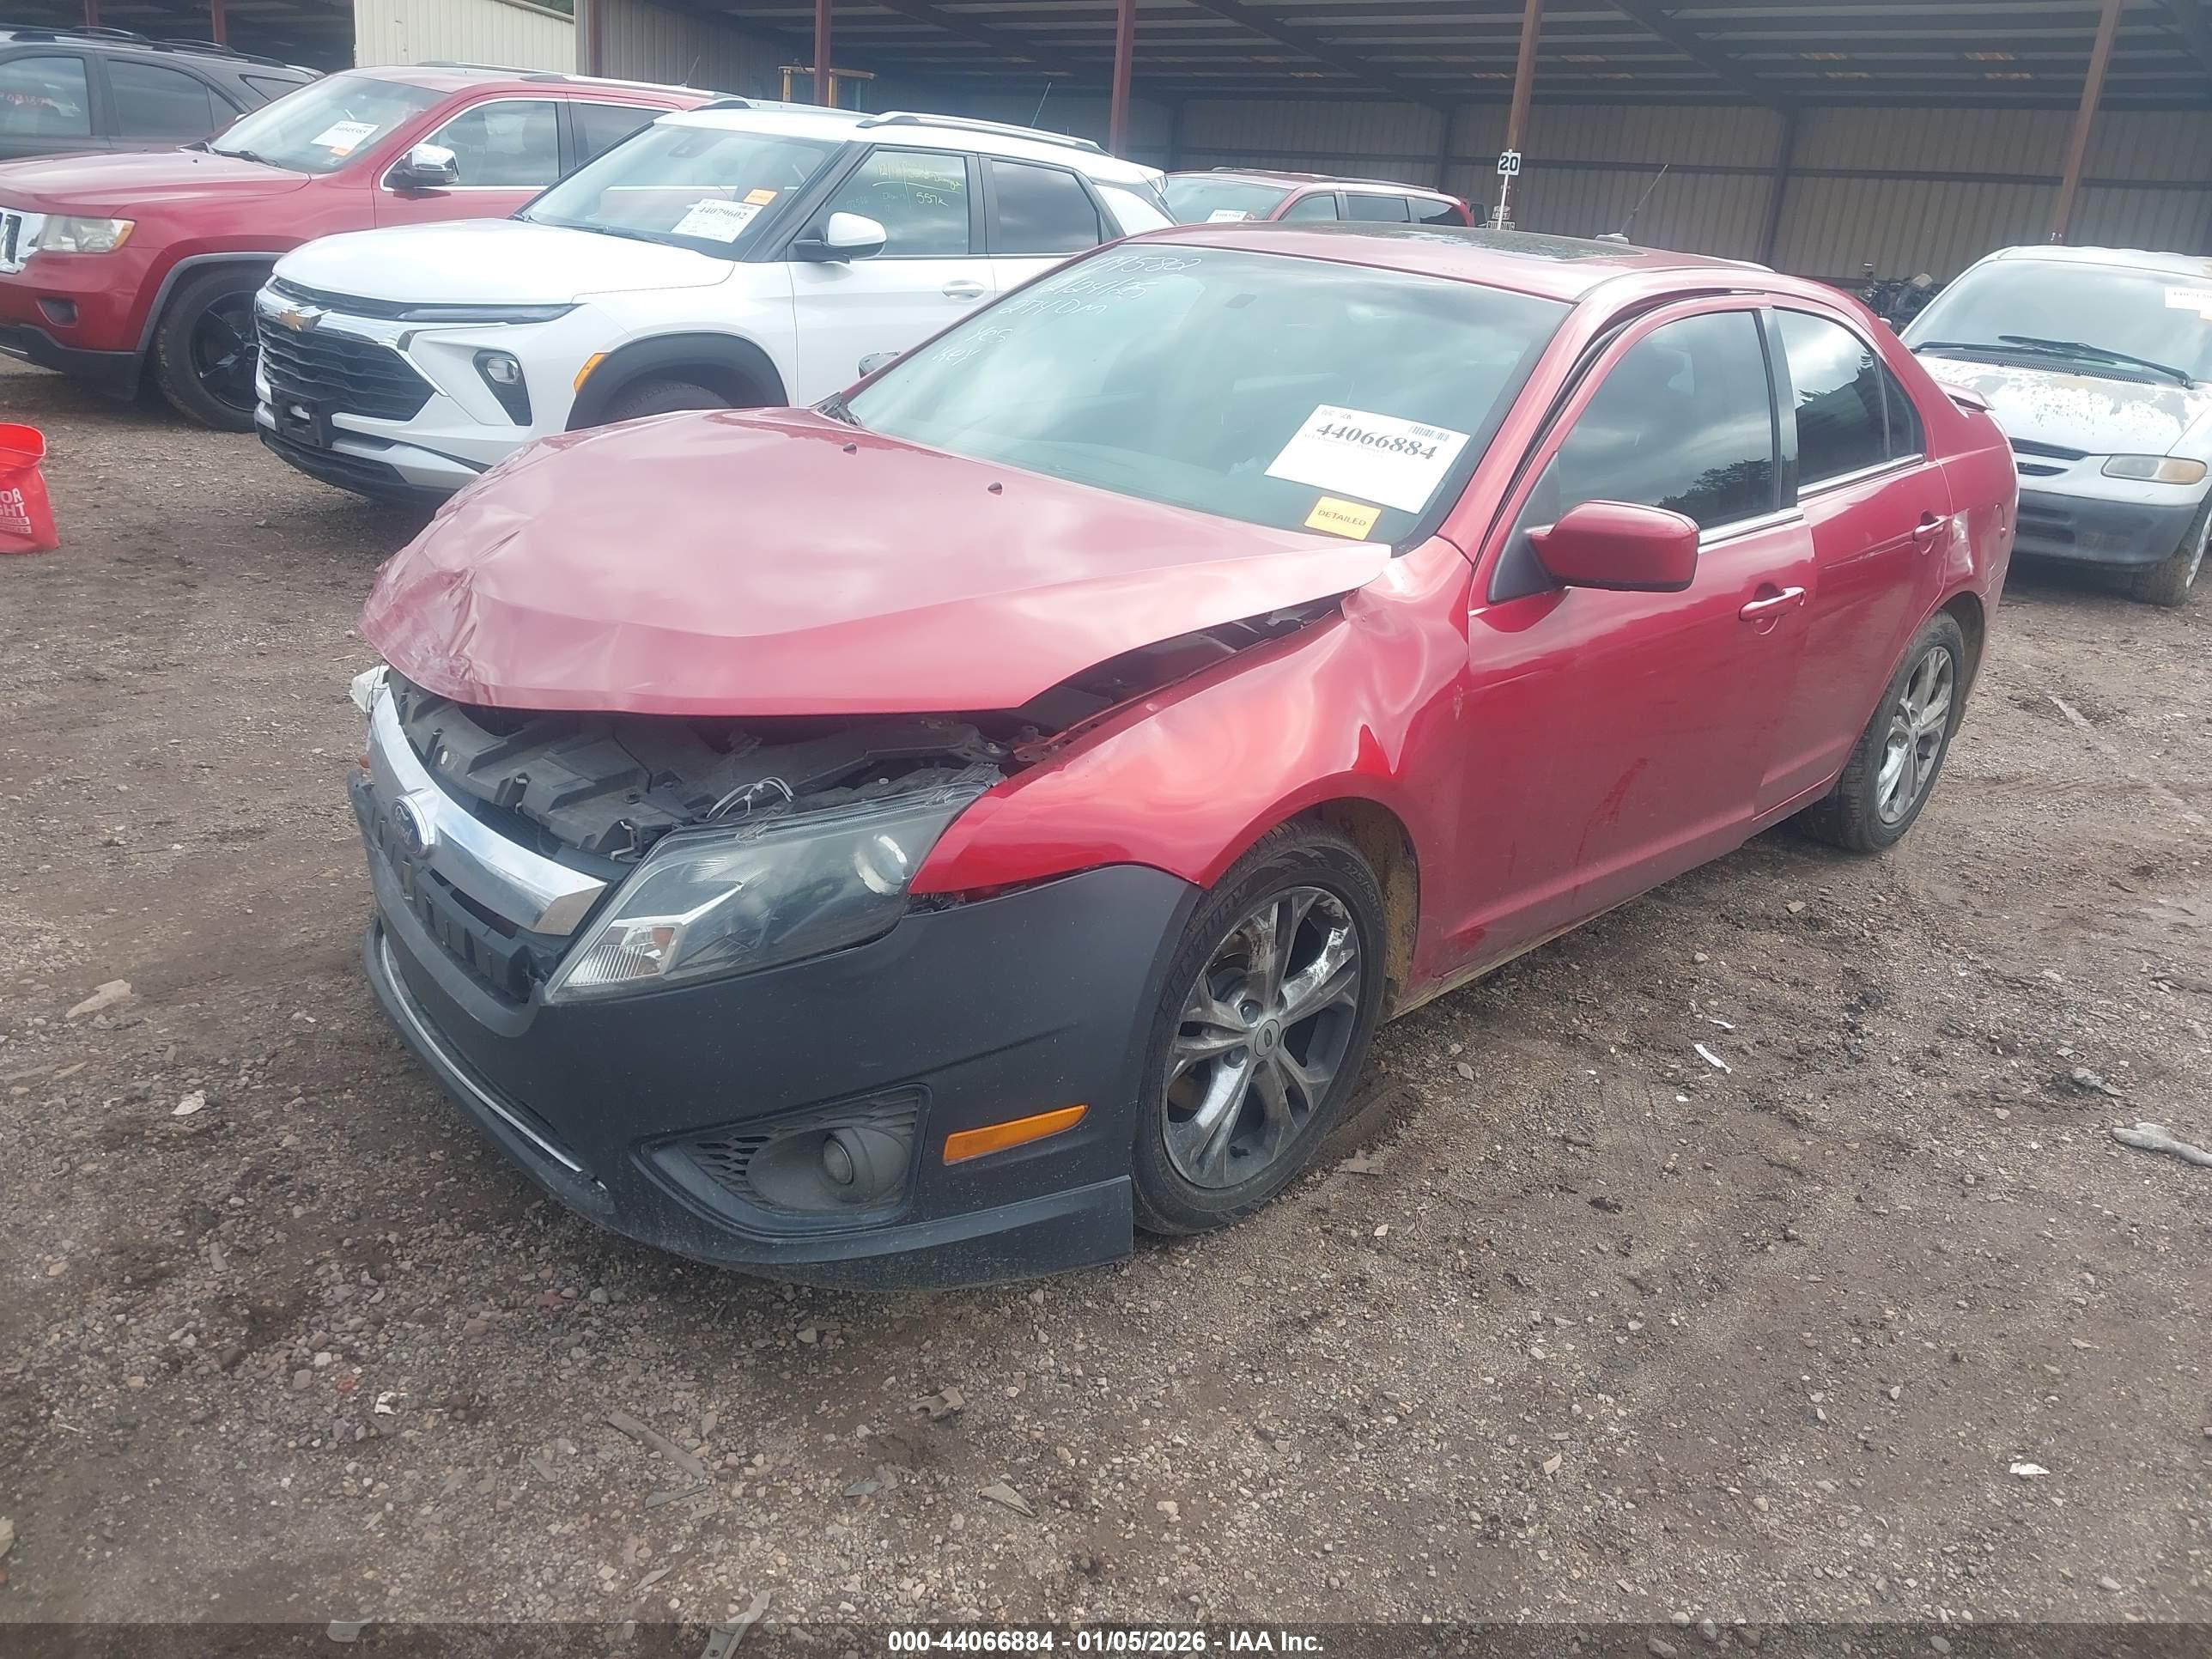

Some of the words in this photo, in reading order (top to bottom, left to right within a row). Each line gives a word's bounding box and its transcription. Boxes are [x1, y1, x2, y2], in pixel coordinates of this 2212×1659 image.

[1498, 155, 1519, 171] 20
[1316, 423, 1437, 459] 44066884
[1317, 509, 1367, 526] DETAILED
